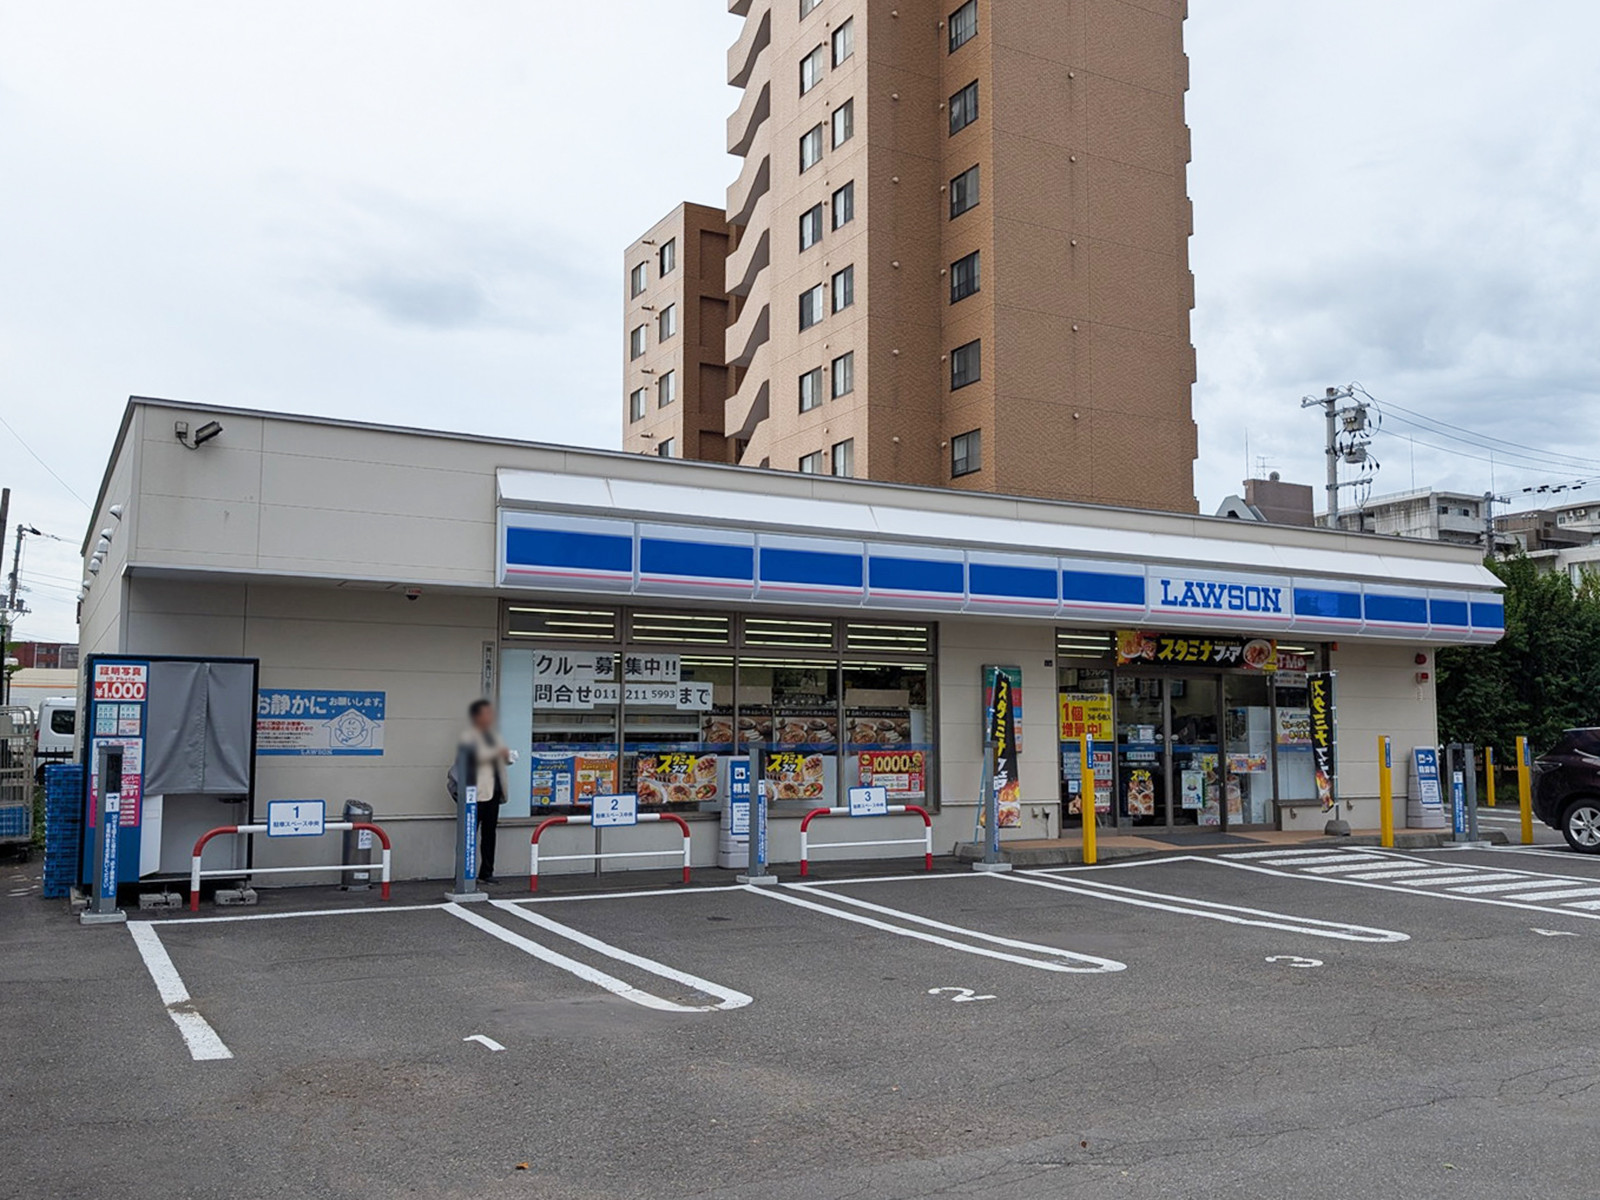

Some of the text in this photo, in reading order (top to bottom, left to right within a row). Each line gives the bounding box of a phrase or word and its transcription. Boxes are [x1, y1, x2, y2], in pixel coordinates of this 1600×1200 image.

[1161, 580, 1281, 613] LAWSON
[100, 666, 141, 676] 証明写真
[95, 683, 145, 698] ¥1,000
[594, 689, 617, 700] 011
[626, 690, 648, 701] 211
[651, 690, 676, 700] 5993
[679, 687, 711, 705] まで
[873, 755, 910, 772] 10000
[864, 791, 871, 802] 3
[293, 806, 299, 818] 1
[611, 799, 618, 810] 2
[1265, 955, 1323, 967] 3
[928, 986, 997, 1002] 2
[463, 1034, 506, 1051] 1
